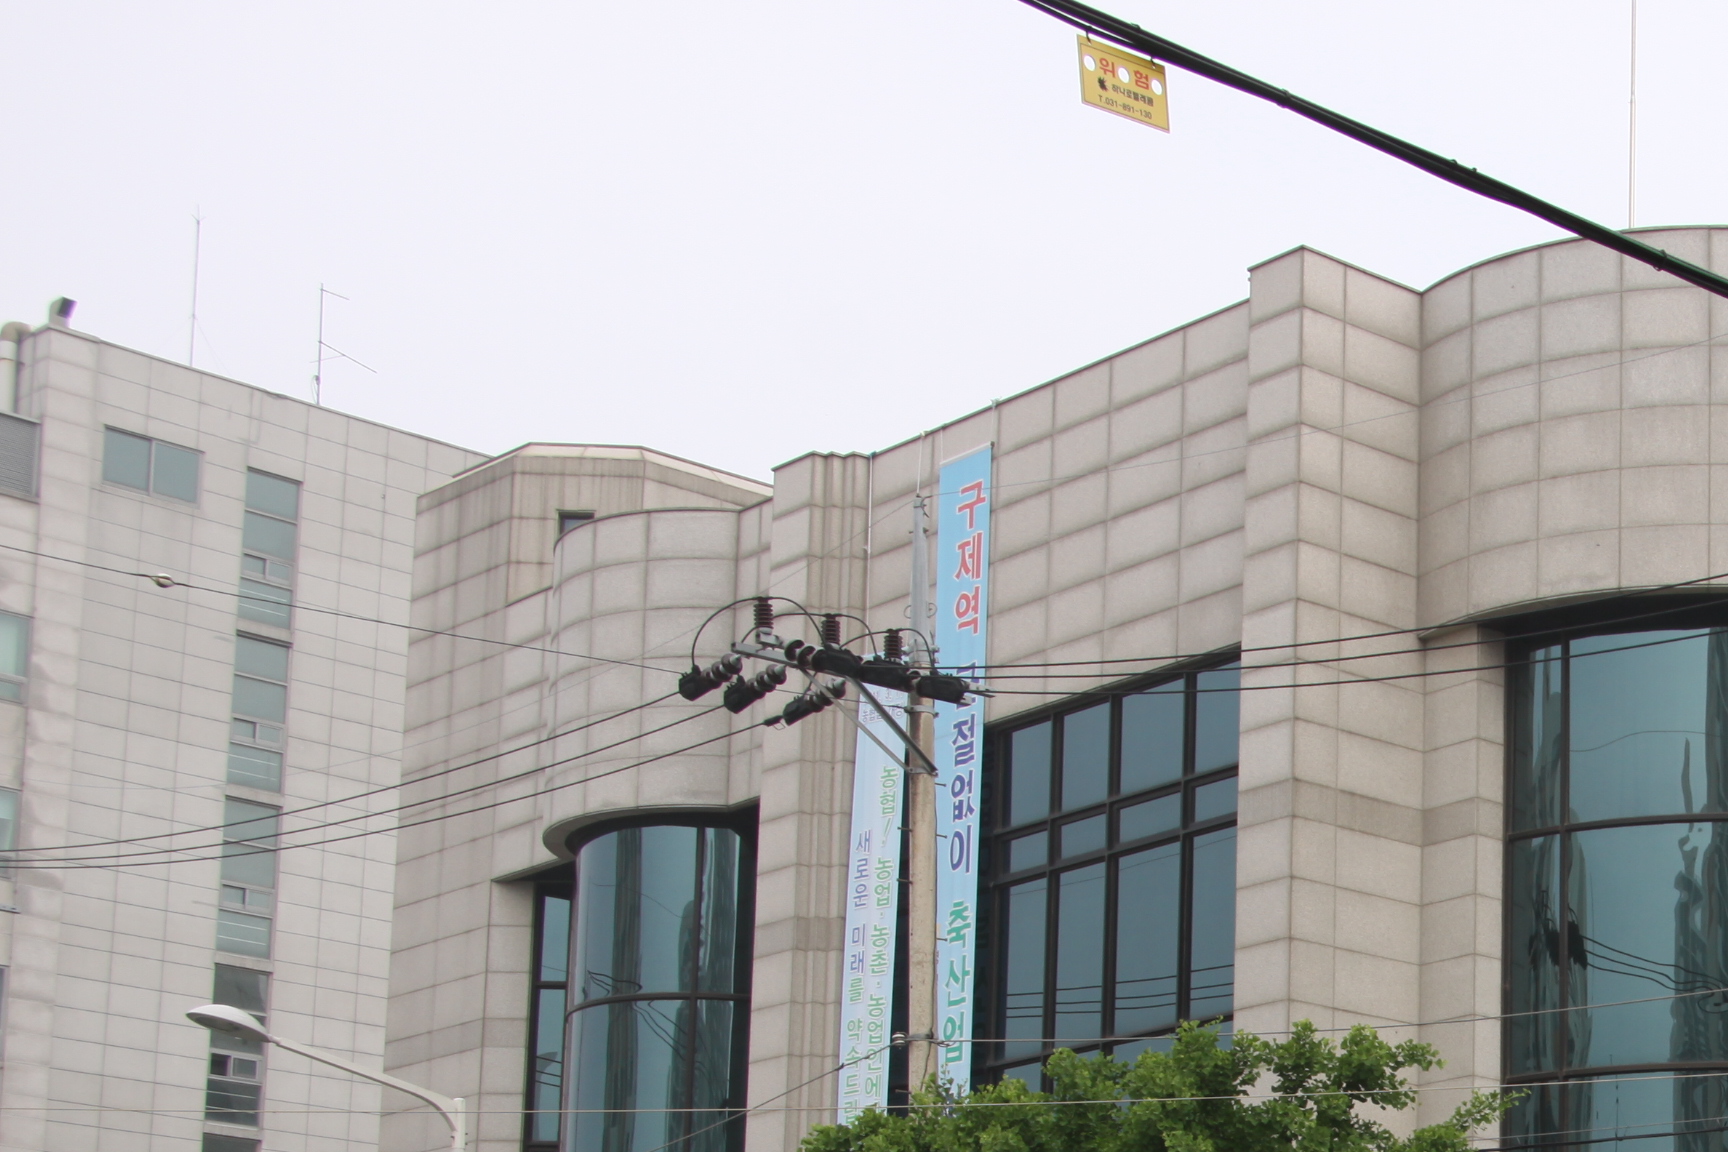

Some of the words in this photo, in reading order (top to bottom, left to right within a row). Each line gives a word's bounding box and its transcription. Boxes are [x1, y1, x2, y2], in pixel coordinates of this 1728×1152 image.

[1099, 57, 1150, 91] 위험
[956, 478, 987, 635] 구제역
[852, 828, 872, 909] 새로운
[847, 923, 867, 1005] 미래를
[942, 899, 972, 1065] 축산업
